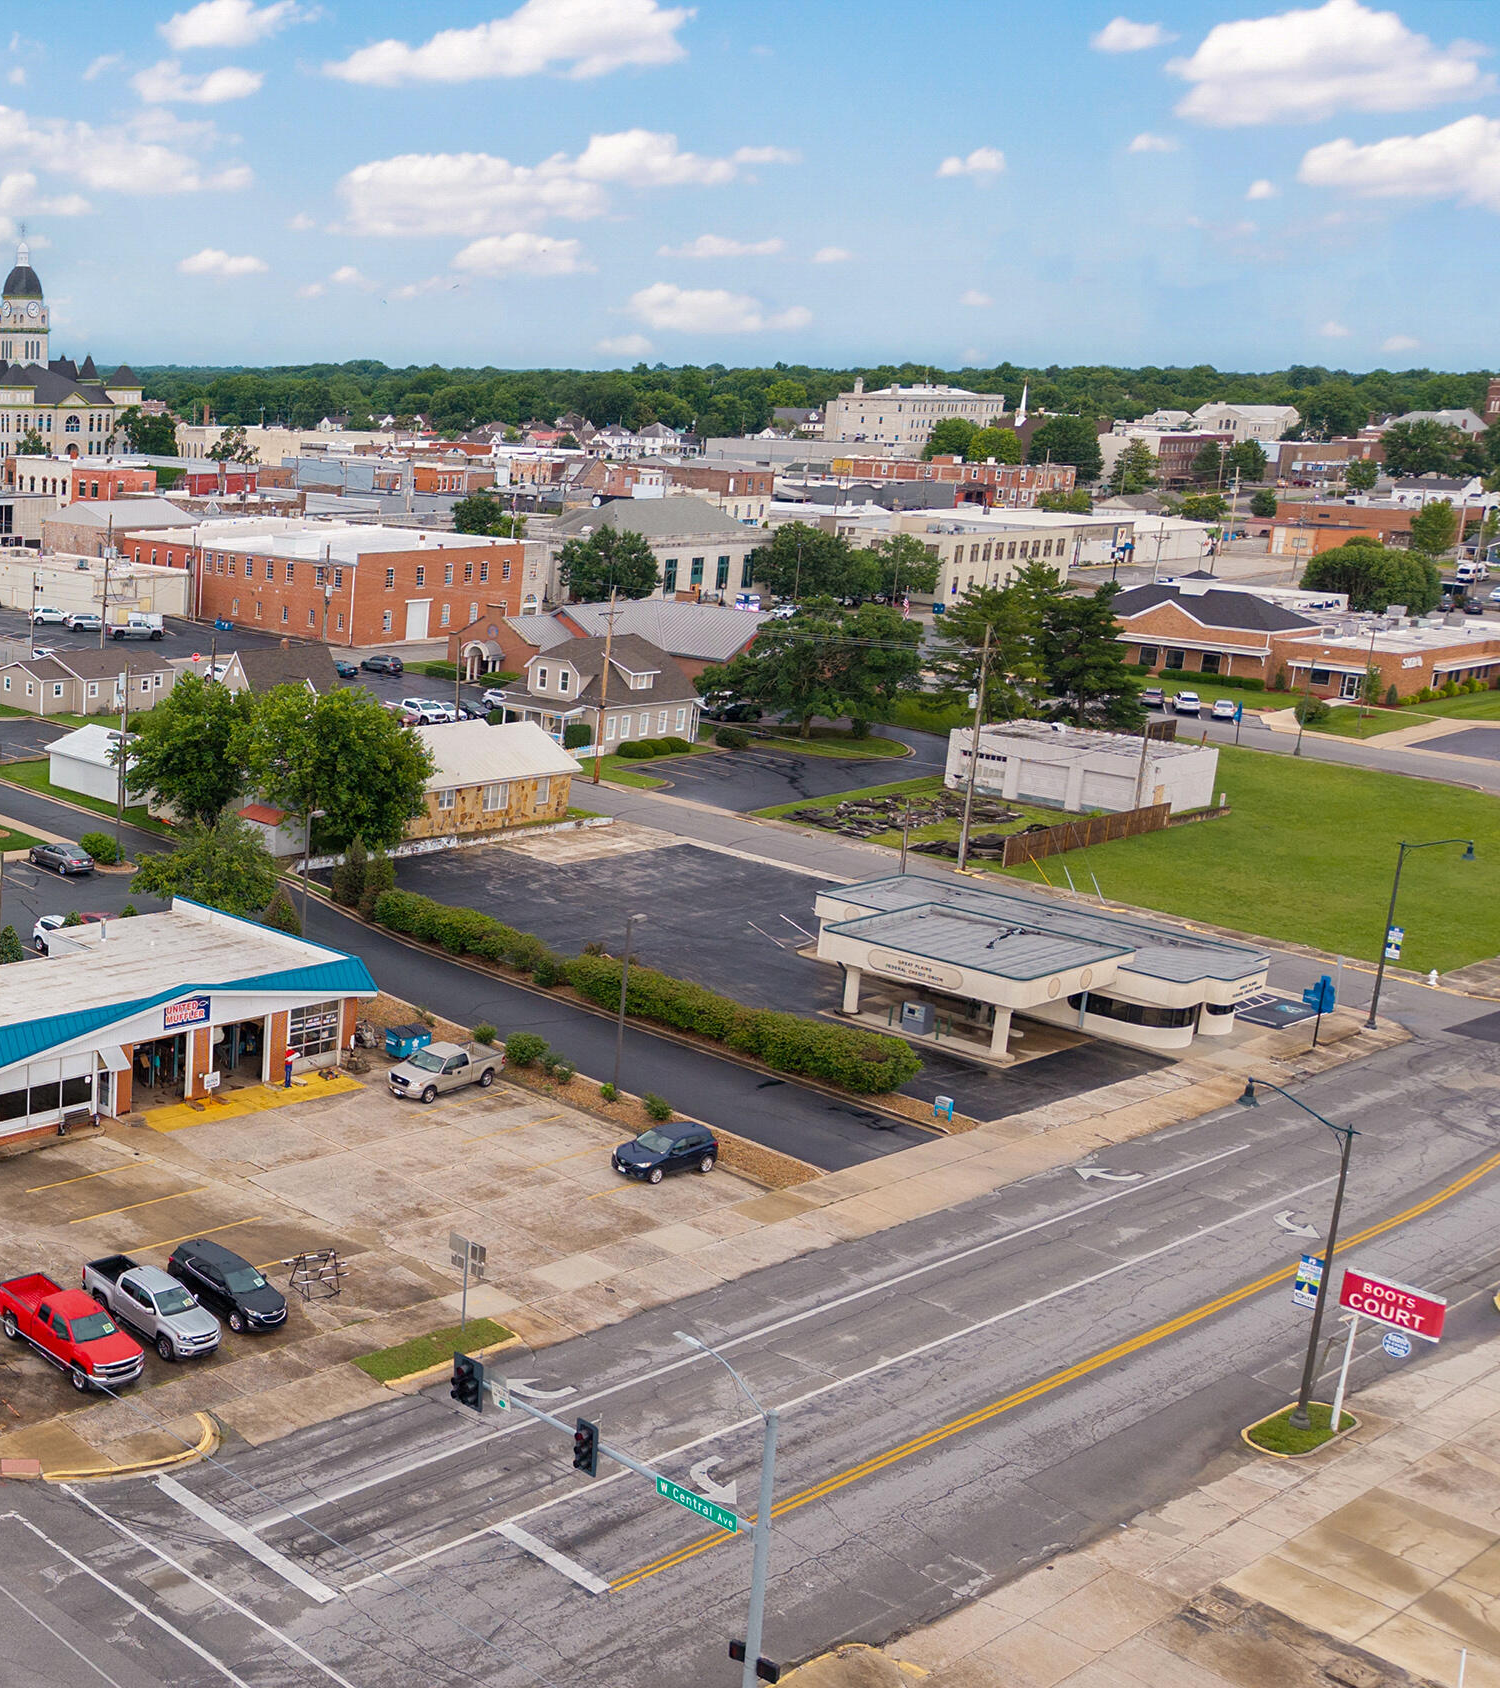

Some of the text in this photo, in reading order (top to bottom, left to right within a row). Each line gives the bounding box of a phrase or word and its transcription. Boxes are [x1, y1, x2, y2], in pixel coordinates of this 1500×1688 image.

[885, 963, 944, 982] FEDERAL CREDIT UNION
[915, 964, 932, 972] PLAINS
[165, 1001, 198, 1015] UNITED
[165, 1009, 205, 1025] MUFFLER
[1362, 1282, 1416, 1309] BOOTS
[1348, 1293, 1425, 1329] COURT
[660, 1481, 733, 1528] W Central Ave
